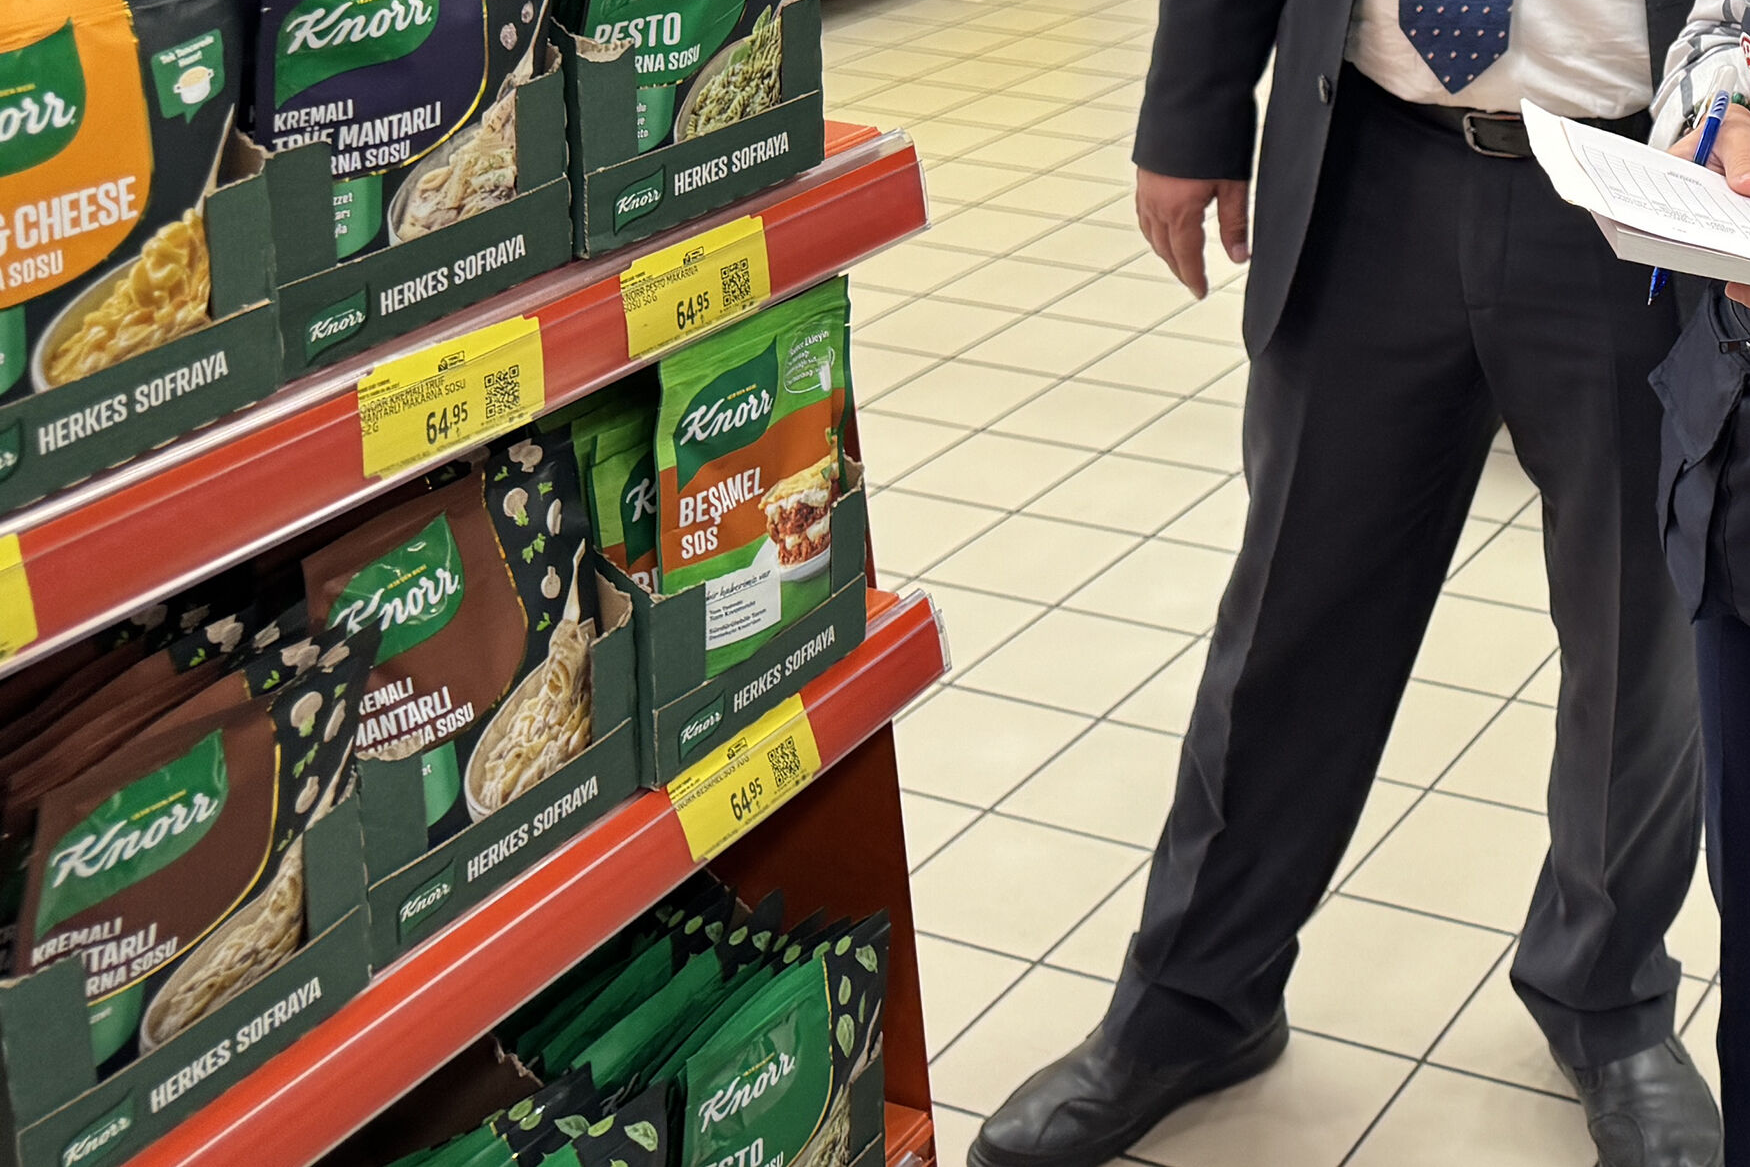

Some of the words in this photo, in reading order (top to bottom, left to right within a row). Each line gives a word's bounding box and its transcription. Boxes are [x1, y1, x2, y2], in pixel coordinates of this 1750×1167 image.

[668, 44, 700, 71] SOSU
[0, 92, 76, 143] orr
[274, 99, 354, 133] KREMALI
[339, 101, 441, 151] MANTARLI
[365, 140, 410, 169] SOSU
[616, 187, 662, 215] Knorr
[674, 155, 728, 196] HERKES
[732, 131, 789, 173] SOFRAYA
[14, 176, 138, 249] CHEESE
[8, 251, 64, 288] SOSU
[309, 308, 367, 342] Knorr
[381, 265, 449, 317] HERKES
[453, 234, 526, 285] SOFRAYA
[38, 396, 128, 455] HERKES
[135, 351, 228, 414] SOFRAYA
[445, 379, 467, 395] SOSU
[679, 390, 774, 446] Knorr
[678, 467, 765, 529] BEŞAMEL
[680, 527, 719, 560] SOS
[325, 567, 460, 638] Knorr
[680, 710, 722, 743] Knorr
[733, 672, 781, 713] HERKES
[785, 625, 836, 677] SOFRAYA
[436, 701, 475, 738] SOSU
[52, 793, 218, 888] Knorr
[400, 882, 451, 923] Knorr
[467, 824, 529, 883] HERKES
[533, 775, 599, 843] SOFRAYA
[32, 918, 123, 967] KREMALI
[131, 937, 178, 979] SOSU
[63, 1115, 130, 1167] Knorr
[150, 1039, 231, 1113] HERKES
[236, 977, 323, 1054] SOFRAYA
[699, 1052, 795, 1133] Knorr
